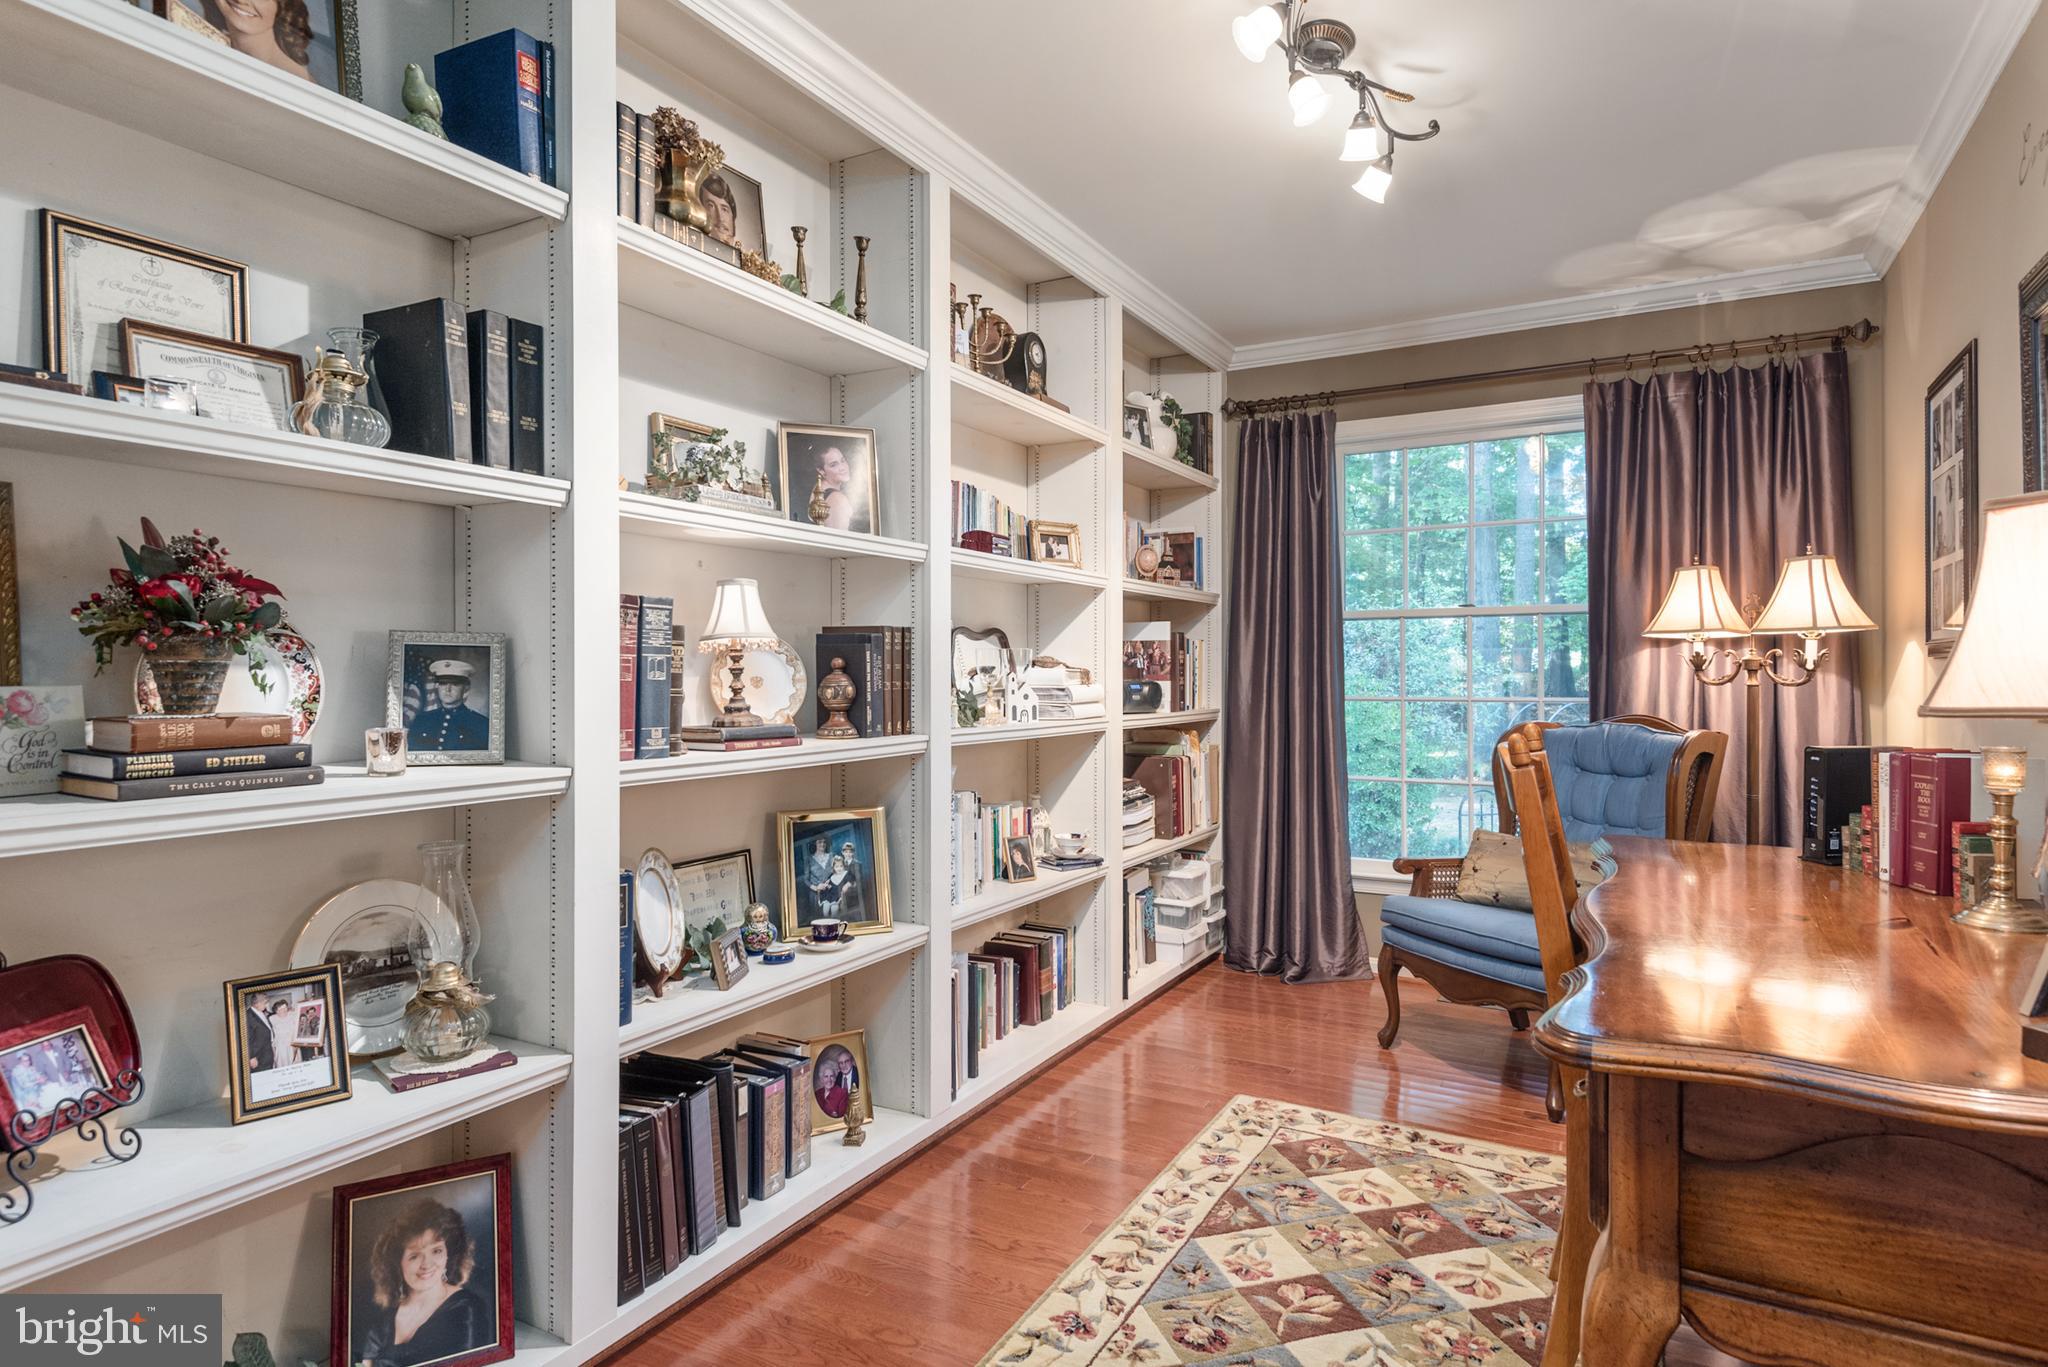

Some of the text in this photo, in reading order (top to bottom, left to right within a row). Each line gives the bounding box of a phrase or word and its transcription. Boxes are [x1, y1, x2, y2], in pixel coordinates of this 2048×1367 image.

[160, 353, 222, 366] COMMONWEALTH
[233, 362, 266, 382] VIRGINIA
[19, 726, 56, 754] God
[167, 723, 176, 747] BIBLE
[177, 723, 185, 746] HAND
[186, 722, 195, 746] BOOK
[27, 748, 48, 758] is in
[126, 754, 174, 765] PLANTING
[206, 754, 266, 768] ED STETZER
[8, 751, 60, 774] Control
[126, 762, 174, 772] MISSIONAL
[126, 769, 174, 779] CHURCHES
[239, 777, 283, 787] GUINNESS
